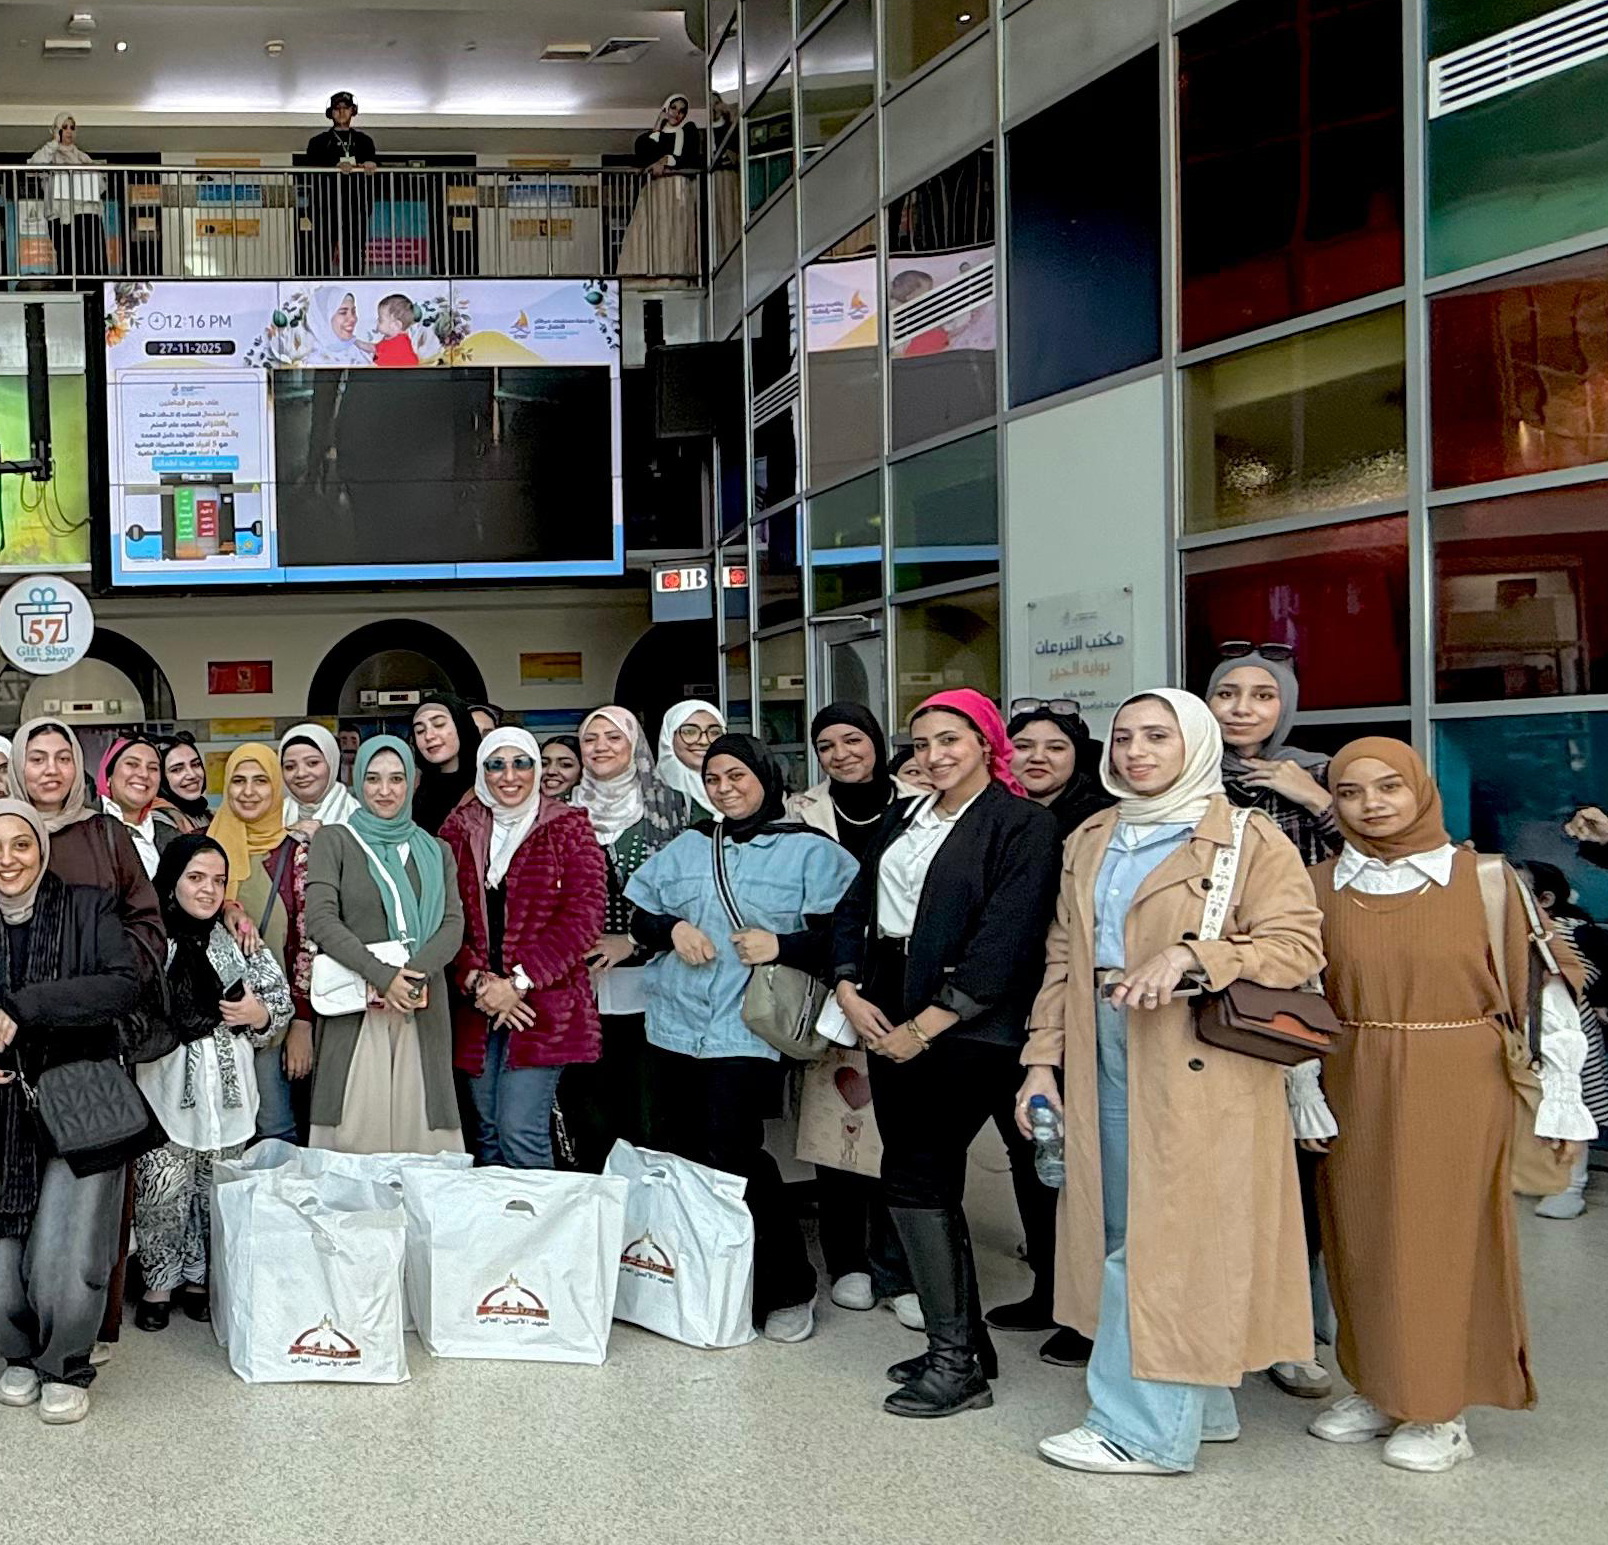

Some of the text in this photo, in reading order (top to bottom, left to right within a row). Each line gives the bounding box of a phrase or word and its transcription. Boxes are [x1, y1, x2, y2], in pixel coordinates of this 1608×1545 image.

[166, 315, 231, 328] 12:16 PM
[159, 343, 222, 354] 27-11-2025
[28, 619, 63, 645] 57
[1035, 631, 1124, 656] مكتب التبرعات
[16, 645, 75, 659] Gift Shop
